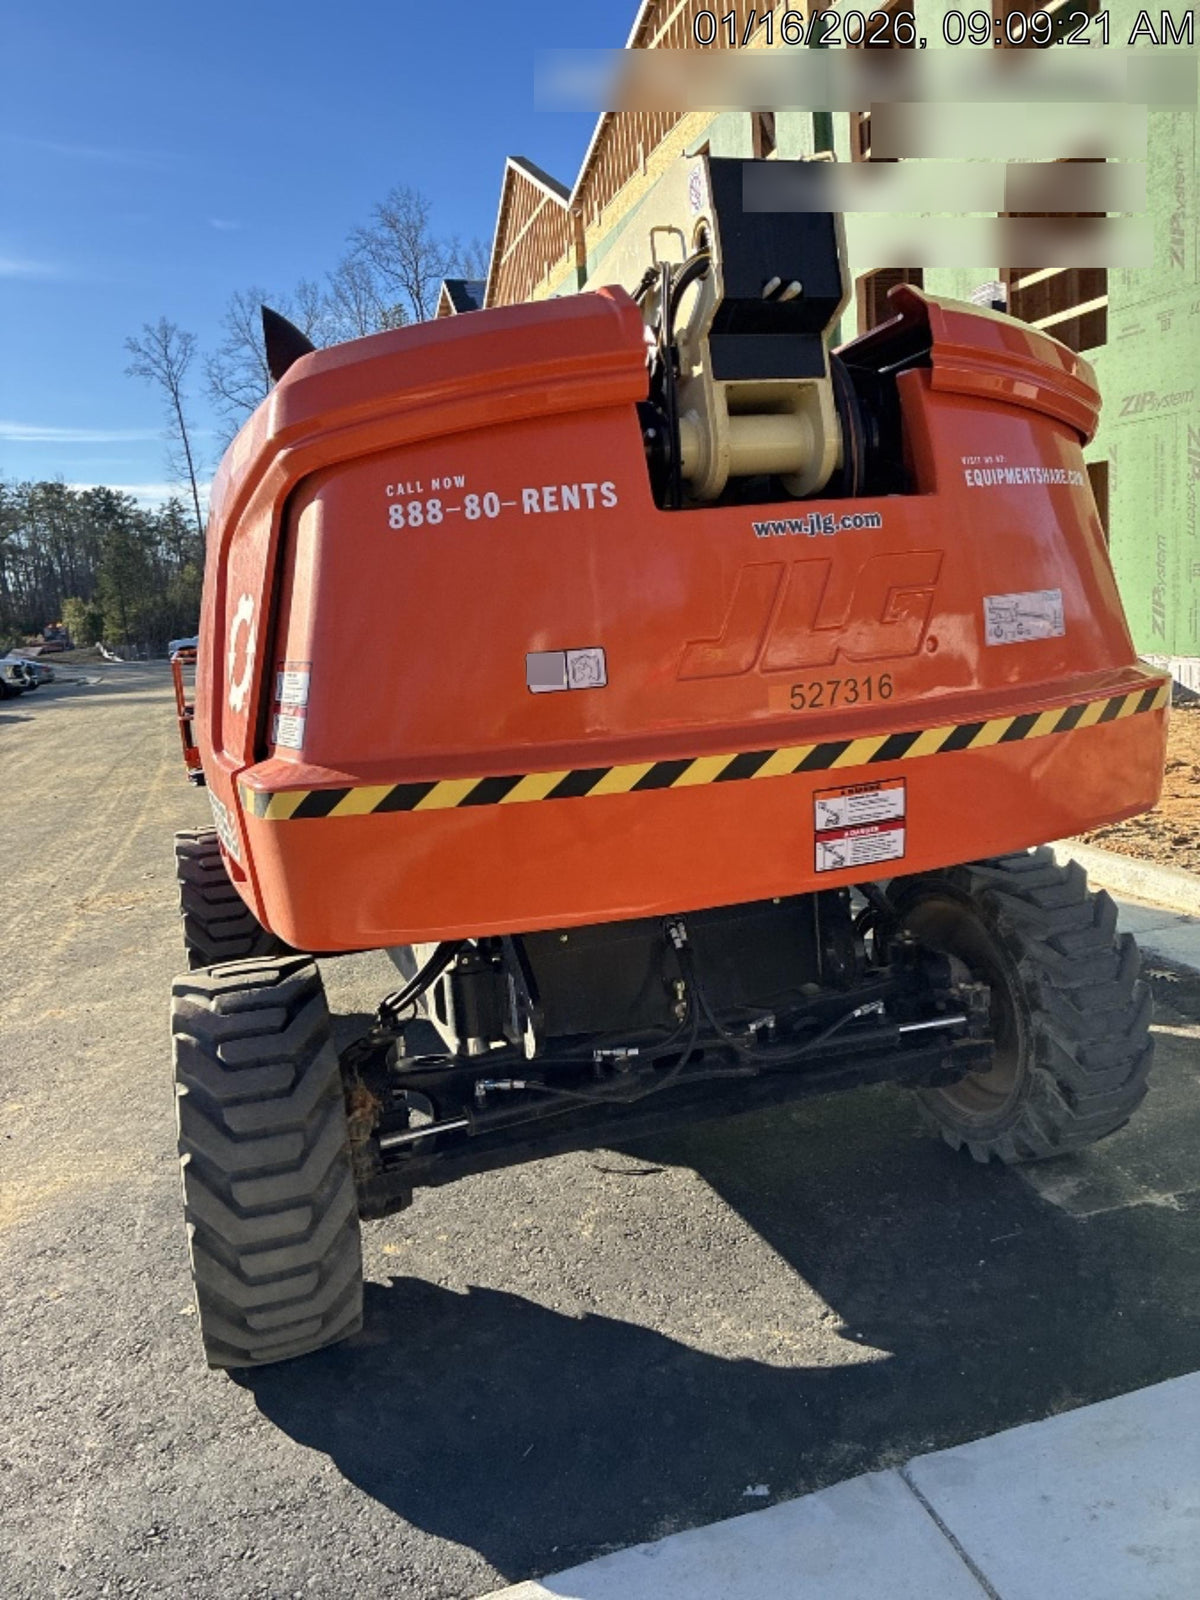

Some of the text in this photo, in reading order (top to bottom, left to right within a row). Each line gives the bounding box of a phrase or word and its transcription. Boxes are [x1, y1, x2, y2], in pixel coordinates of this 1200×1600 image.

[386, 475, 466, 497] CALL NOW
[388, 480, 618, 530] 888-80-RENTS
[753, 511, 882, 538] www.jlg.com
[676, 549, 944, 682] JLG
[789, 673, 894, 711] 527316
